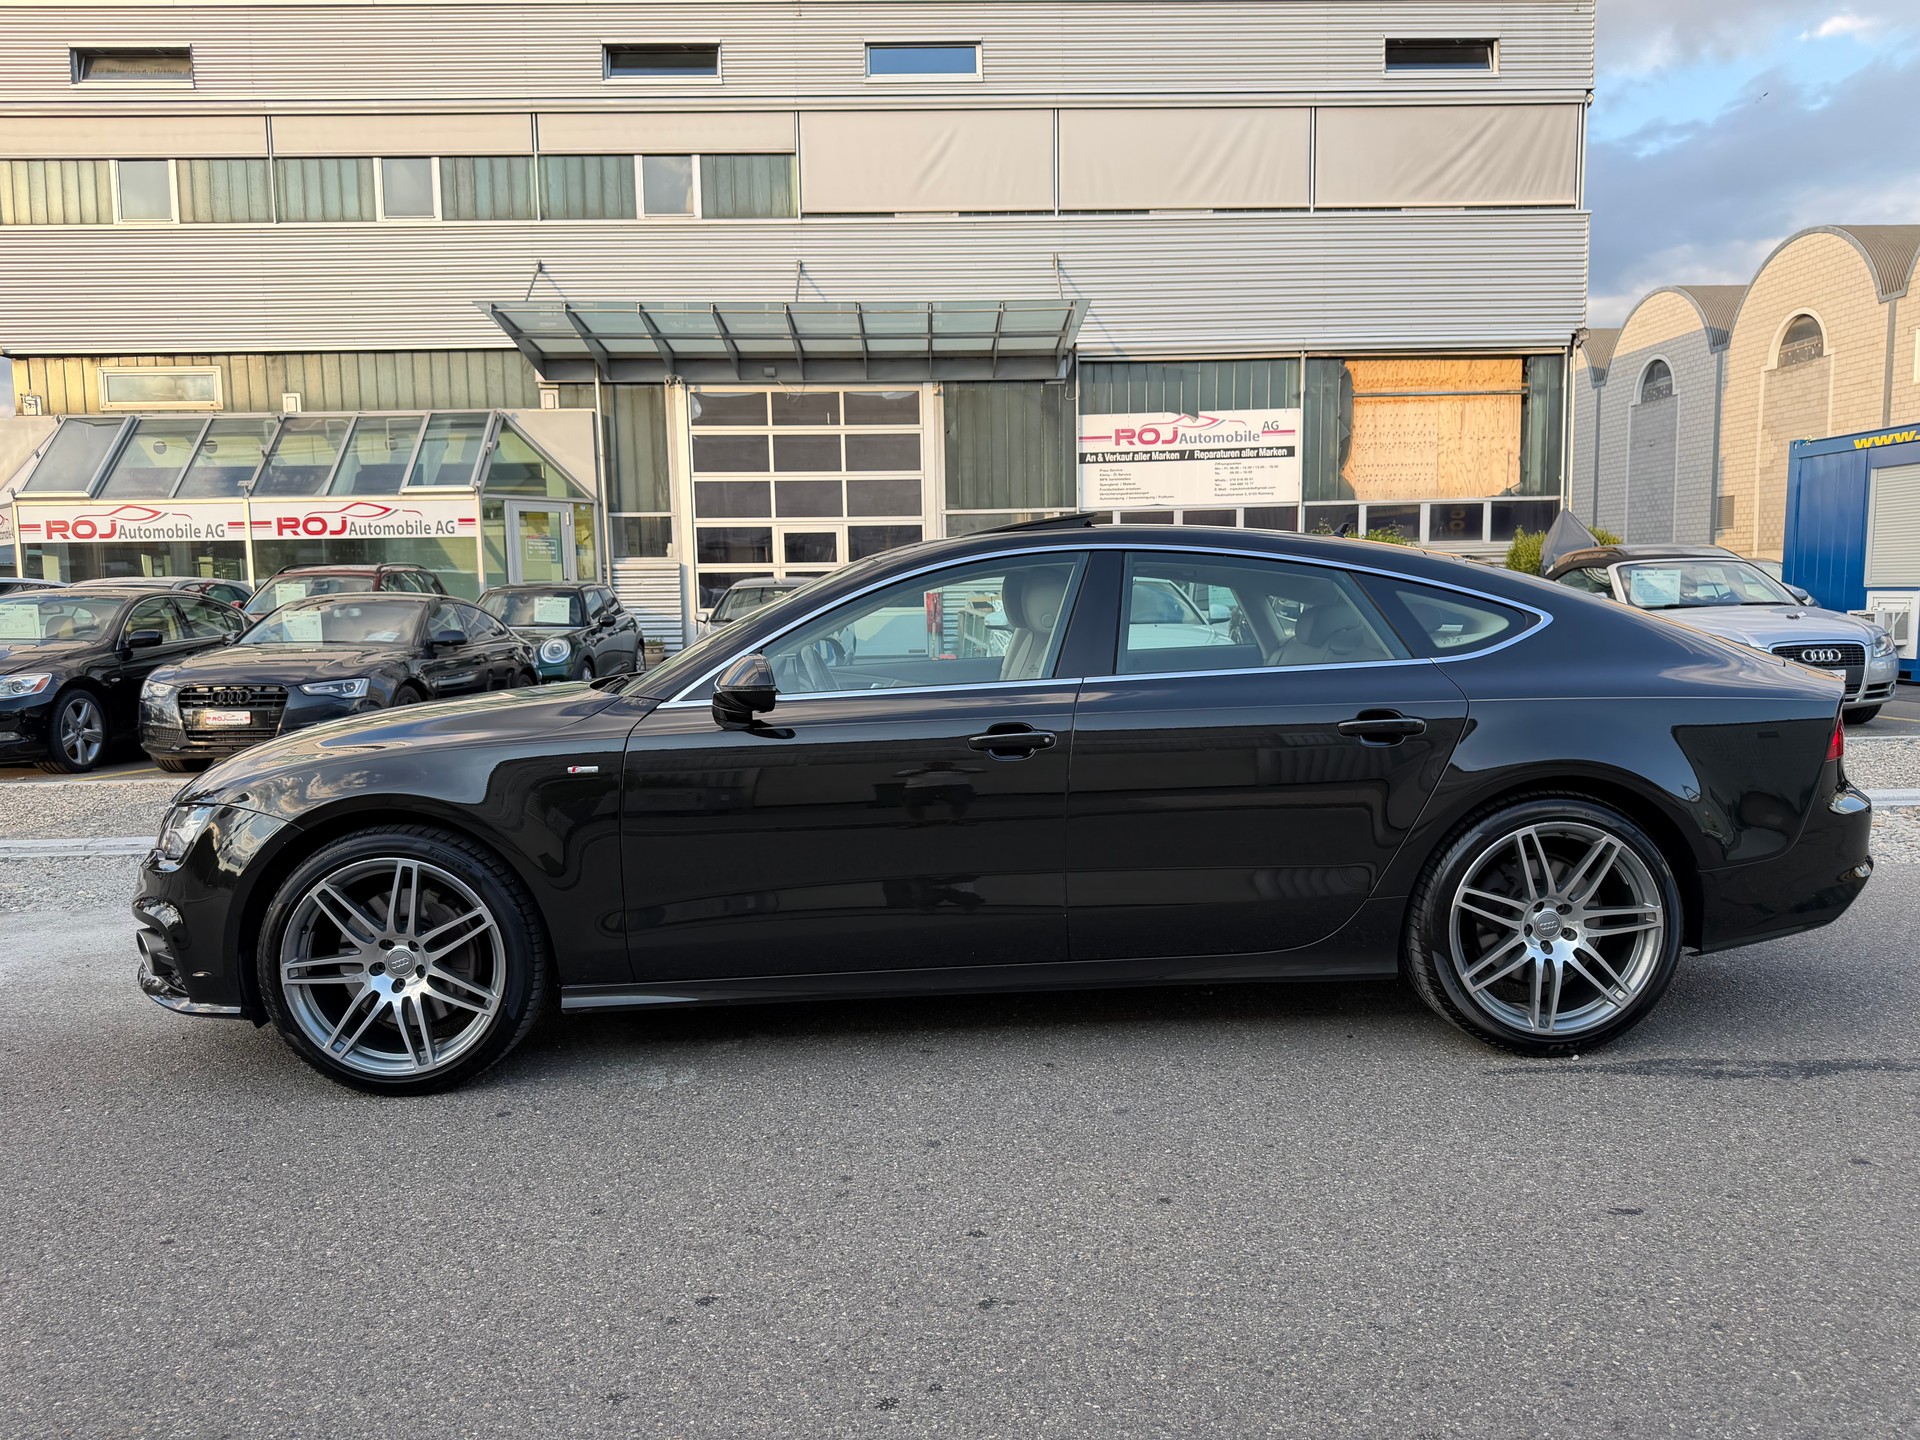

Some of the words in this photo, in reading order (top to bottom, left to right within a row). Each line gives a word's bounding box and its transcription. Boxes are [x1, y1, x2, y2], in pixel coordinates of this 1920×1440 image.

[1115, 427, 1178, 446] ROJ
[1179, 430, 1260, 444] Automobile
[1263, 420, 1280, 431] AG
[1085, 453, 1096, 463] An
[1097, 453, 1104, 462] &
[1104, 451, 1133, 462] Verkauf
[1134, 451, 1151, 461] aller
[1151, 450, 1180, 461] Marken
[1194, 449, 1240, 460] Reparaturen
[1241, 448, 1258, 458] aller
[1258, 447, 1288, 457] Marken
[45, 519, 117, 539] ROJ
[118, 523, 202, 539] Automobile
[205, 523, 225, 538] AG
[277, 516, 347, 536] ROJ
[348, 520, 432, 536] Automobile
[435, 520, 455, 534] AG
